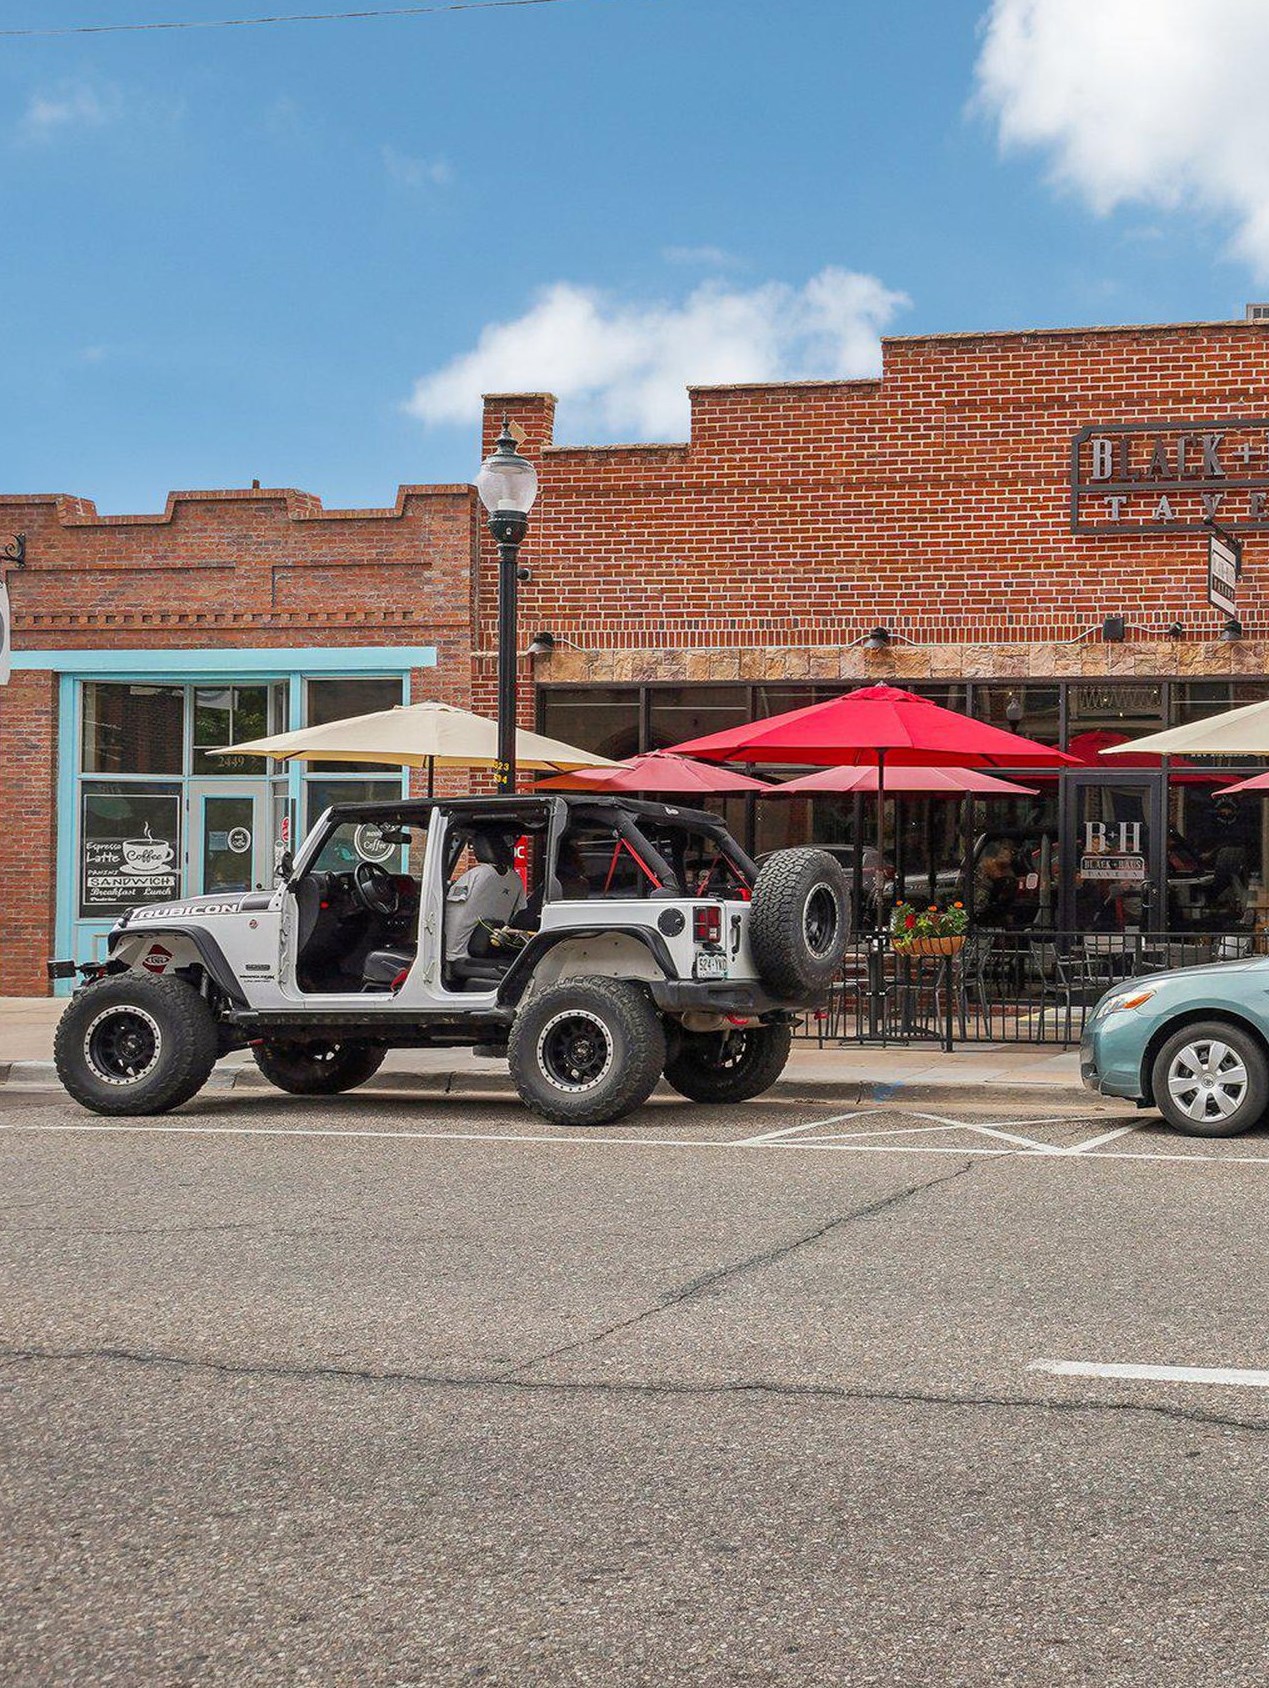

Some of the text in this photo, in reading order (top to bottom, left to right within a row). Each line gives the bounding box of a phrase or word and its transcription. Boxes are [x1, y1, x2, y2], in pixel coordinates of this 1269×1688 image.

[1090, 434, 1225, 481] BLACK
[364, 838, 387, 852] Coffee
[86, 852, 120, 862] Latte
[127, 849, 163, 863] Coffee
[90, 878, 170, 887] SANDWICH
[90, 887, 172, 897] Breakfast Lunch
[141, 904, 239, 919] RUBICON
